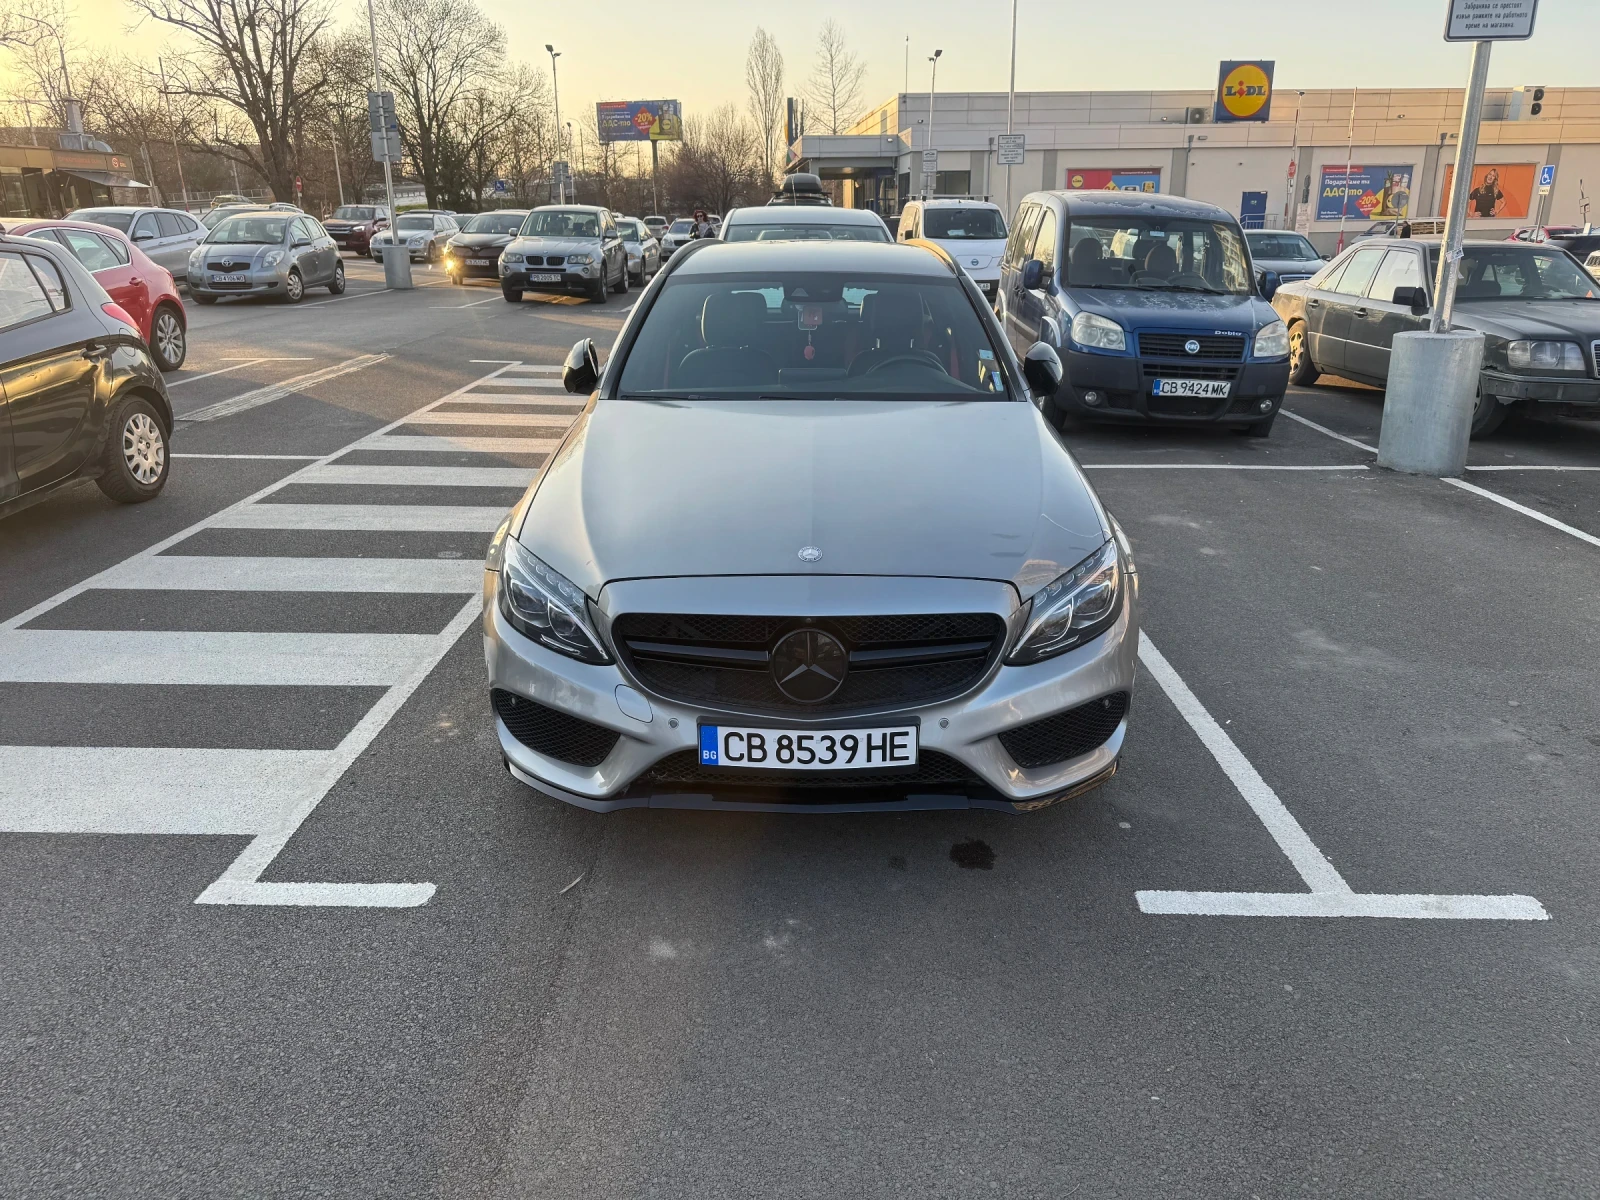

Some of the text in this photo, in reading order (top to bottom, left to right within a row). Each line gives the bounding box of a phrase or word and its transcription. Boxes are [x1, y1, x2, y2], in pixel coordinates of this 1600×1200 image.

[1464, 2, 1490, 10] Забранява
[1472, 12, 1492, 20] рамките
[1503, 11, 1528, 19] работното
[1359, 196, 1377, 205] -20%
[1162, 382, 1226, 395] CB 9424 MK
[724, 731, 910, 764] CB 8539 HE
[703, 751, 716, 760] BG
